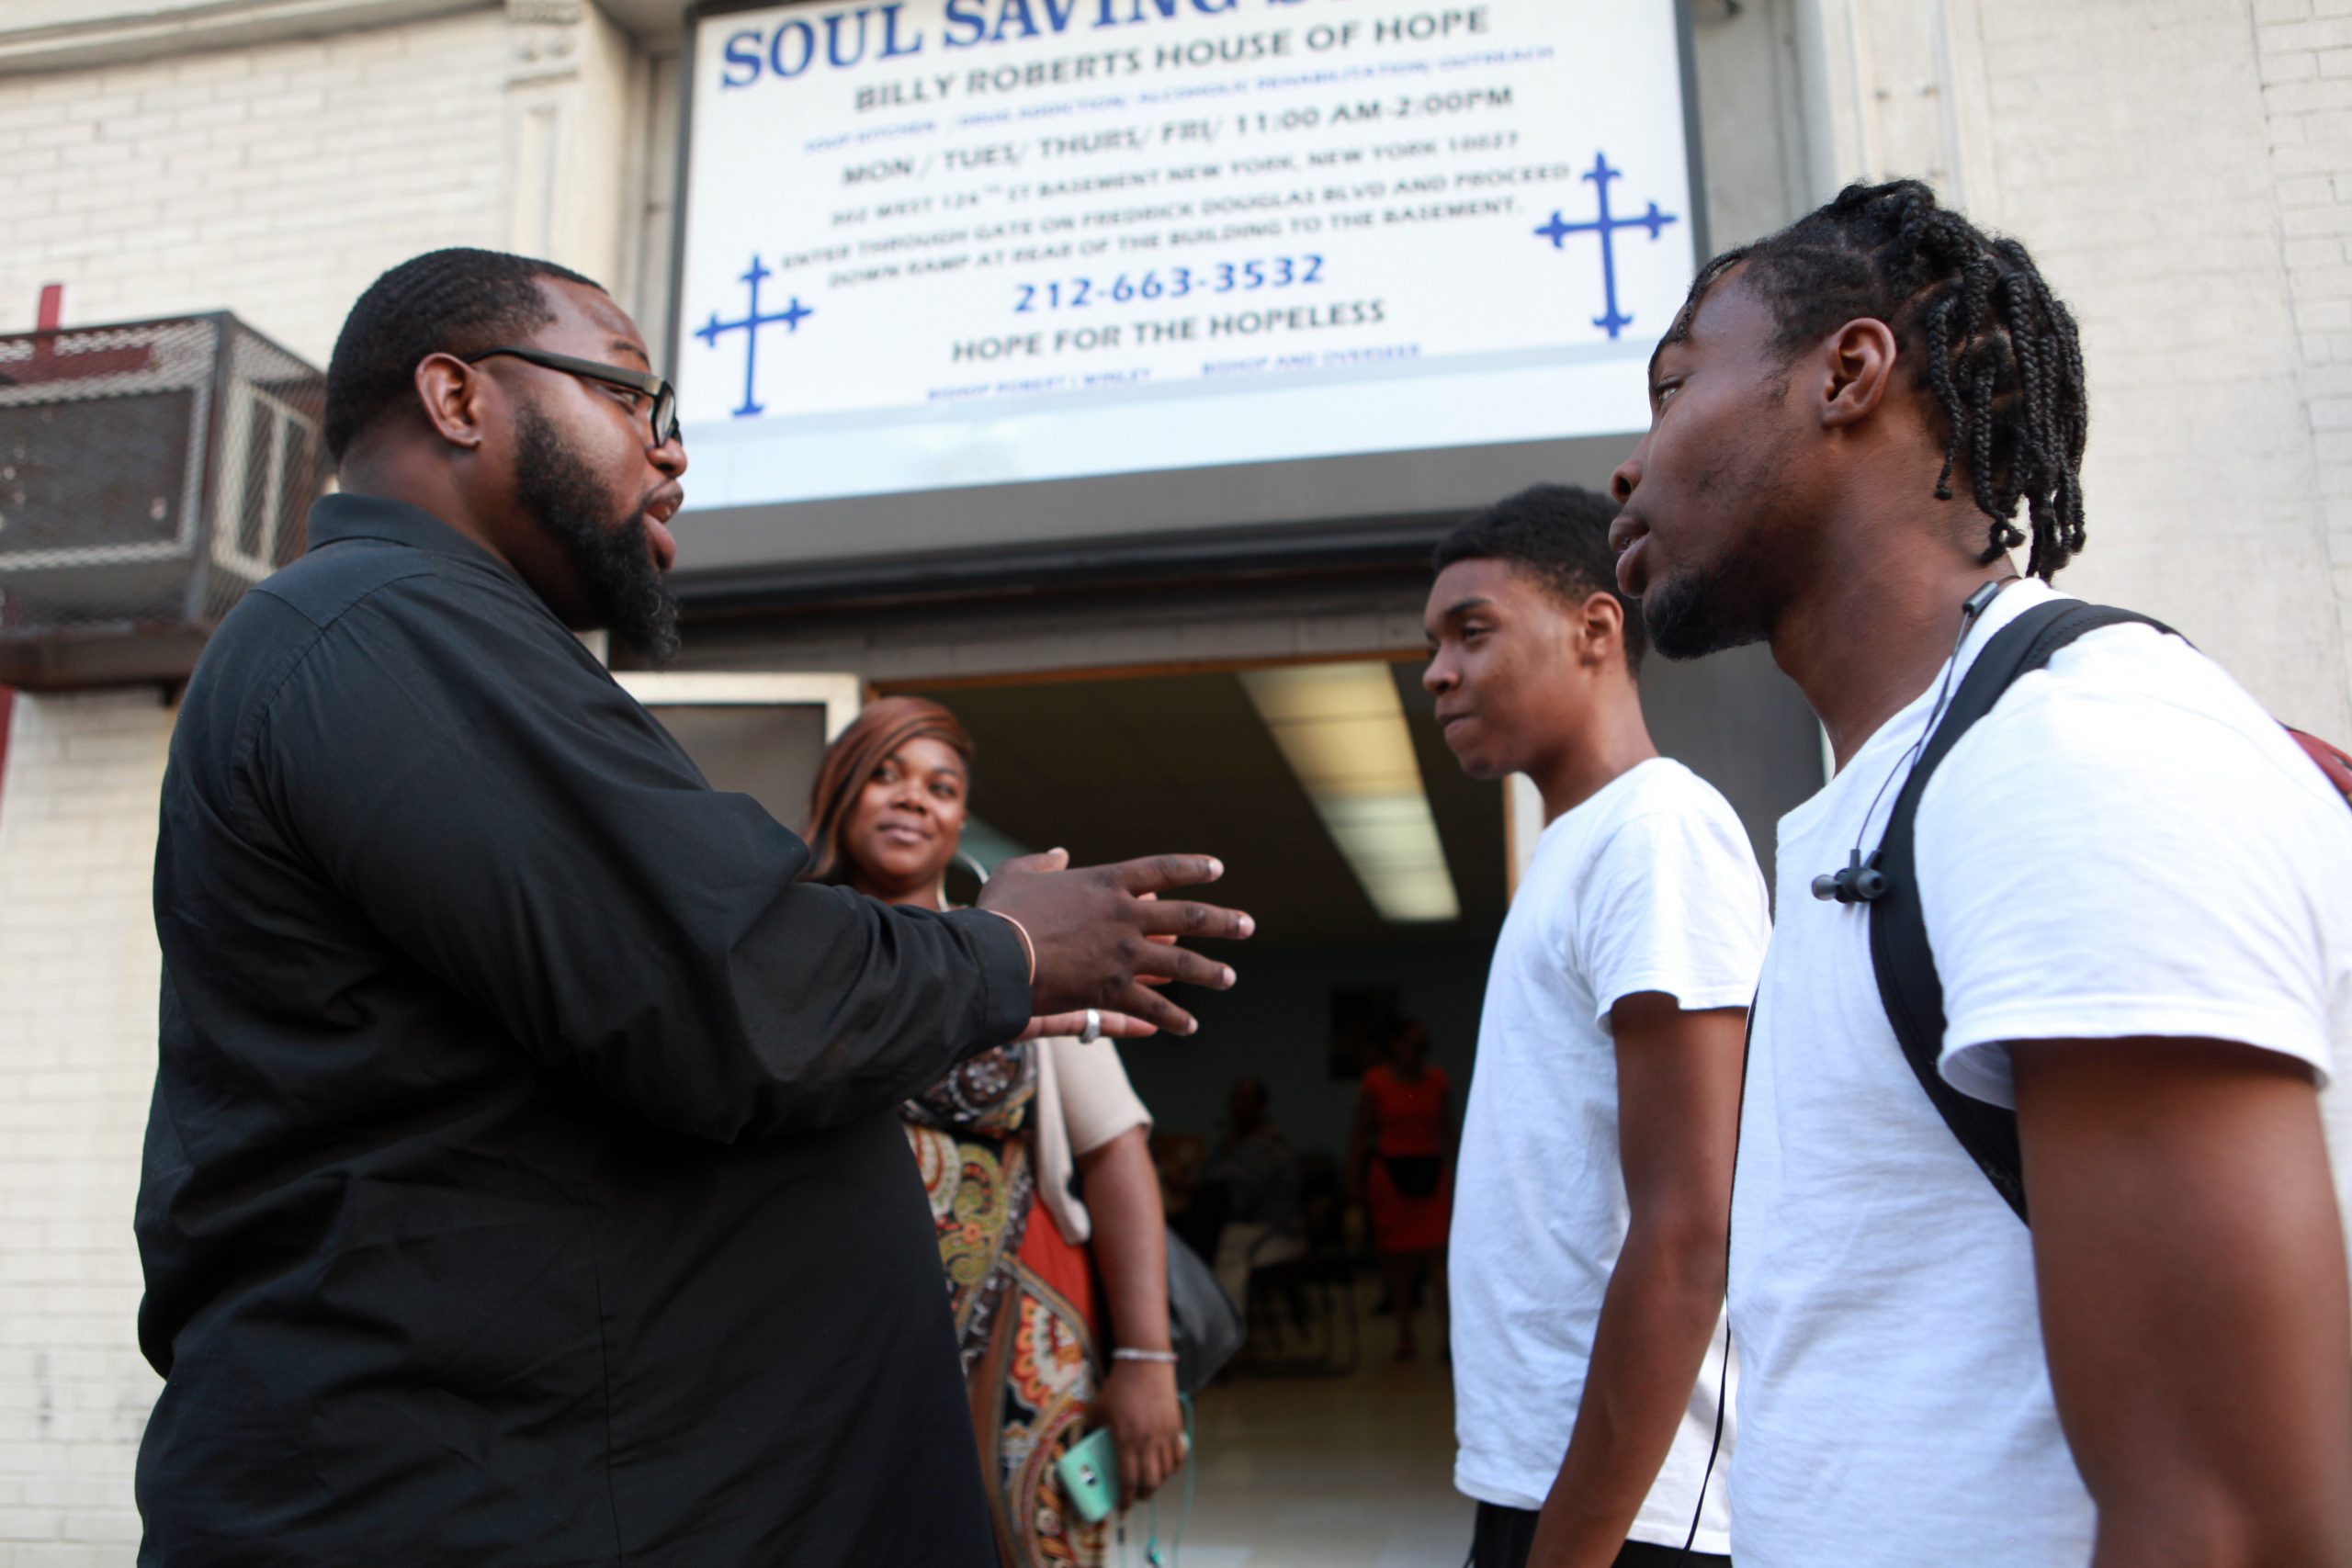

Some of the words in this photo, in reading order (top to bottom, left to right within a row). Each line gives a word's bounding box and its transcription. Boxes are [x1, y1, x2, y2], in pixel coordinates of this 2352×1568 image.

[721, 2, 921, 90] SOUL
[943, 0, 1240, 48] SAVIN
[855, 73, 956, 111] BILLY
[967, 46, 1143, 96] ROBERTS
[1155, 29, 1294, 69] HOUSE
[1306, 19, 1360, 50] OF
[1375, 6, 1491, 42] HOPE
[842, 158, 913, 185] MON
[1038, 123, 1154, 157] THURS/
[1235, 107, 1321, 134] 11:00
[1013, 254, 1325, 313] 212-663-3532
[952, 331, 1043, 364] HOPE
[1054, 324, 1121, 352] FOR
[1133, 314, 1198, 344] THE
[1209, 299, 1385, 337] HOPELESS
